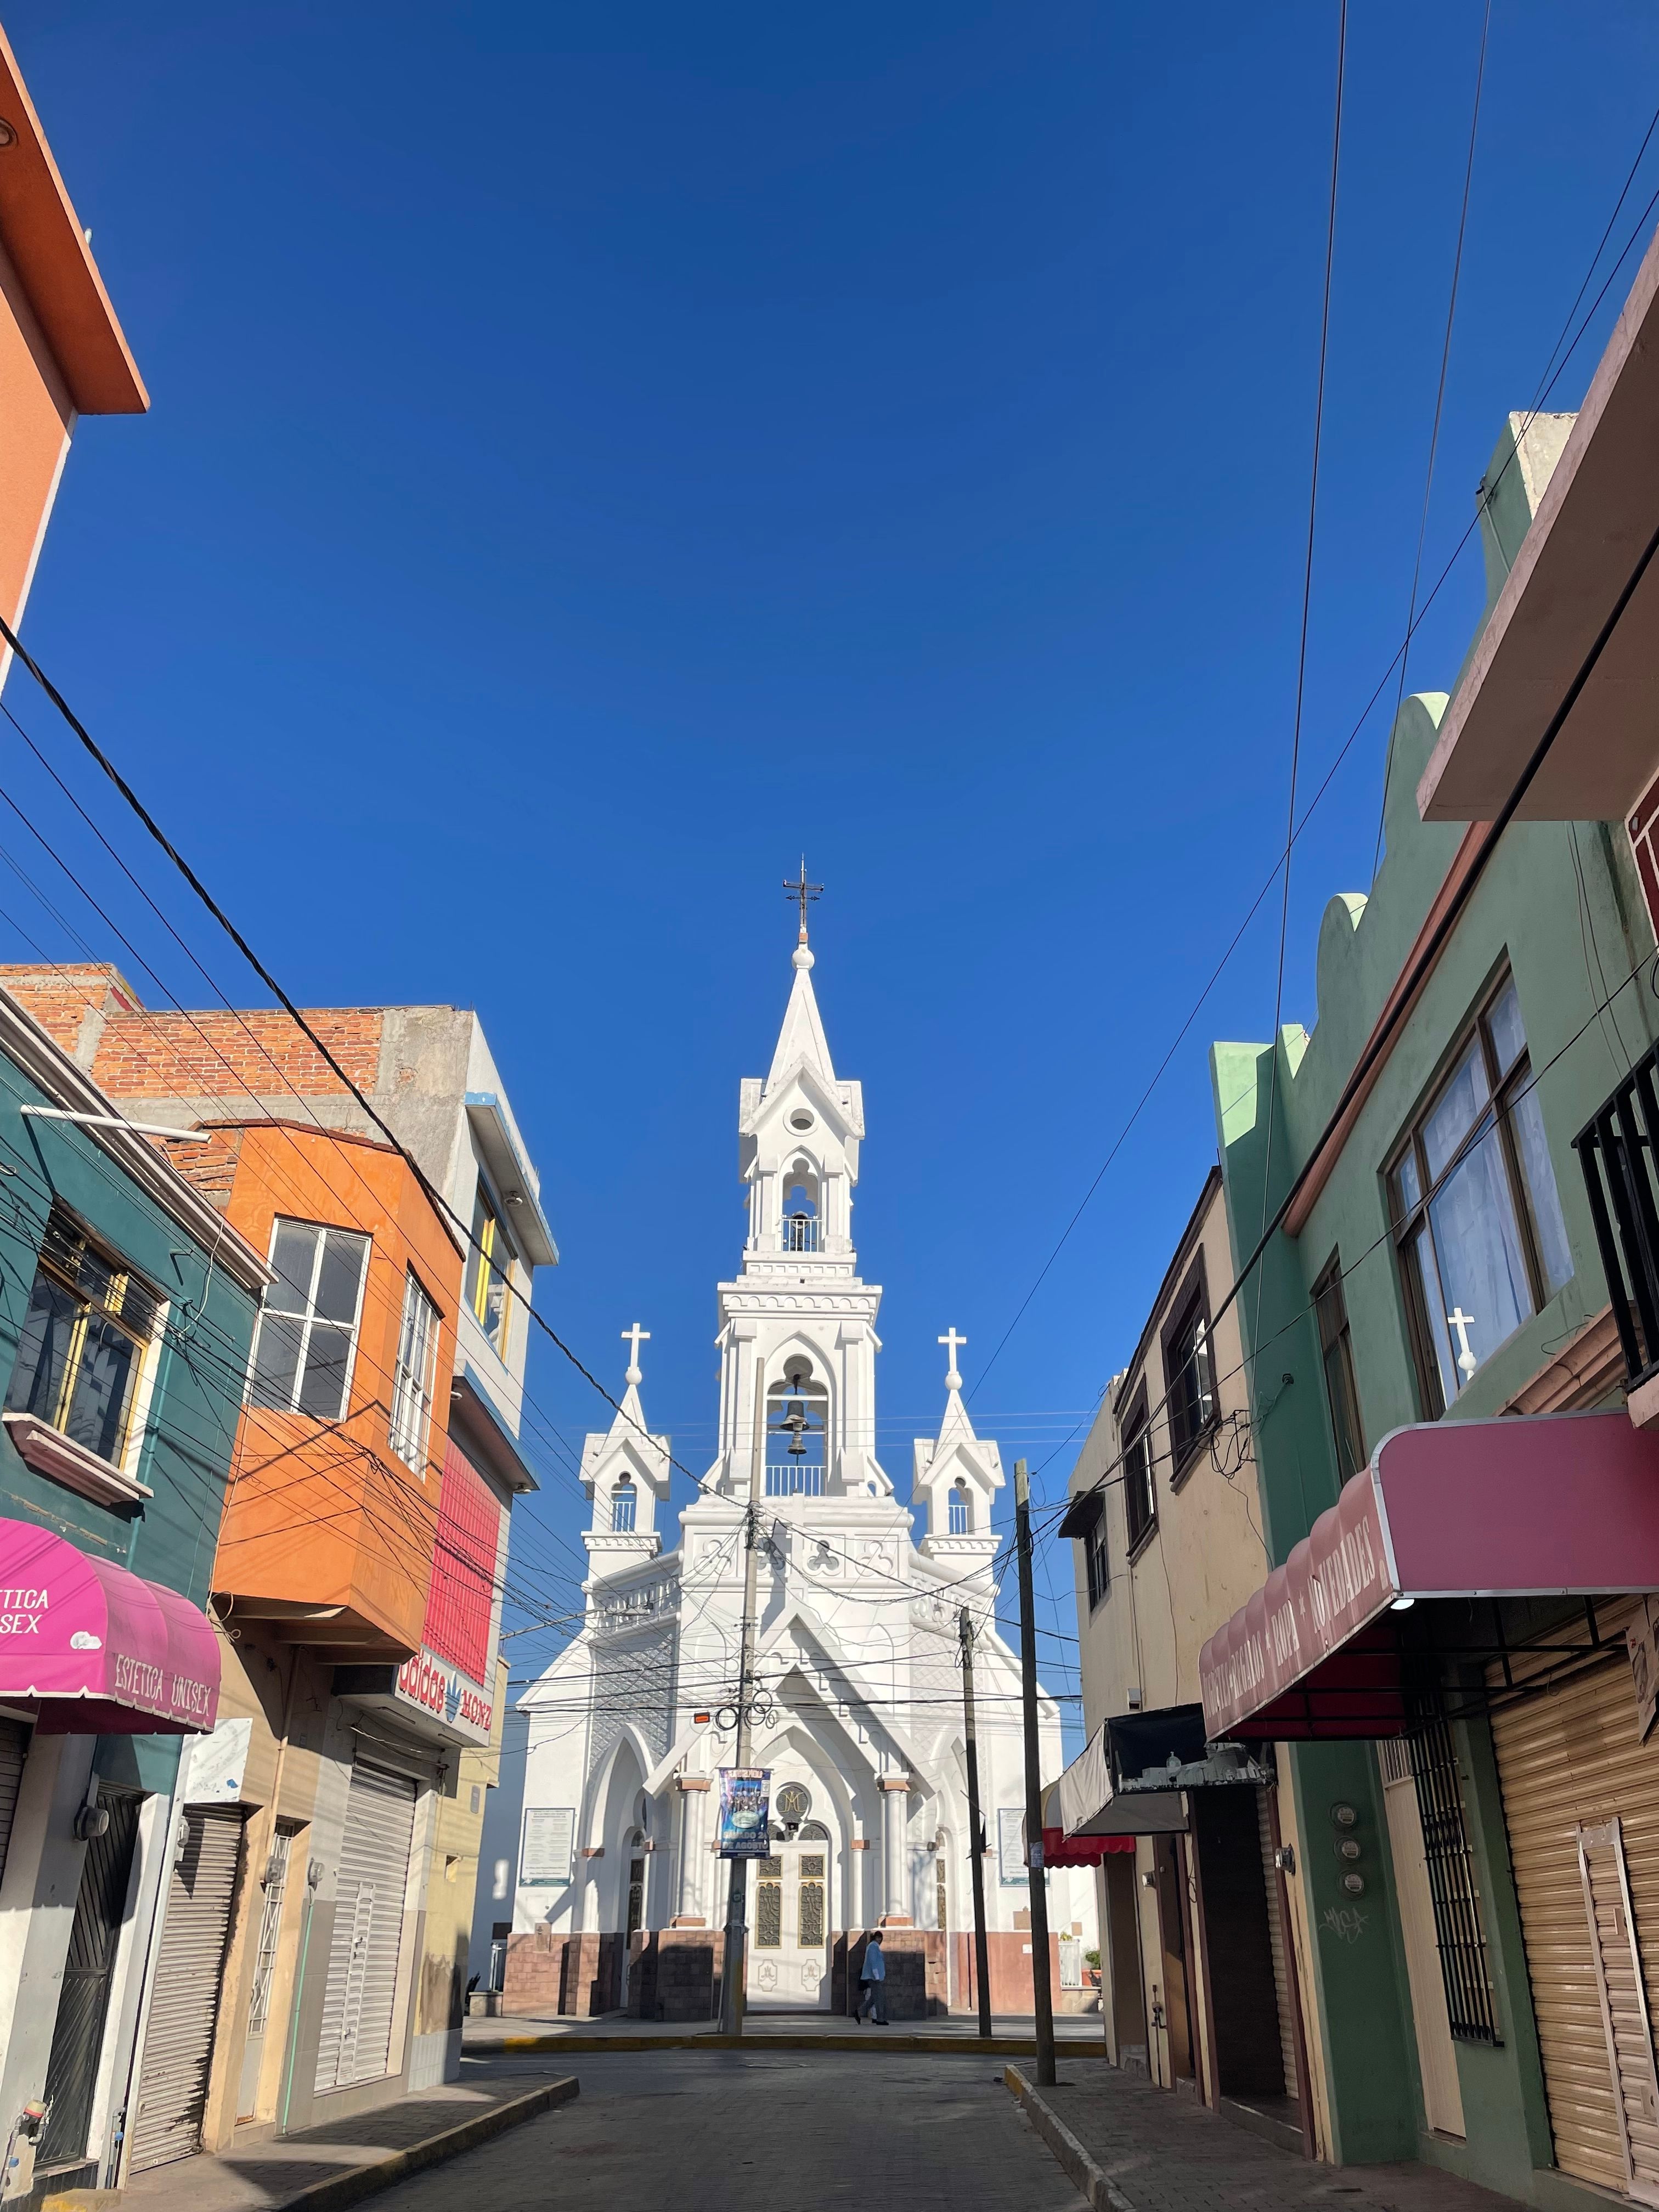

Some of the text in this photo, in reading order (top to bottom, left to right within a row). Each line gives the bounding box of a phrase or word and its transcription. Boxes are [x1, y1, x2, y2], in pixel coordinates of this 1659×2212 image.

[0, 1589, 49, 1609] TICA
[1231, 1630, 1265, 1700] REGALOS
[1271, 1599, 1300, 1667] ROPA
[1307, 1515, 1375, 1634] NOVEDADES
[115, 1654, 212, 1717] ESTETICA UNISEX
